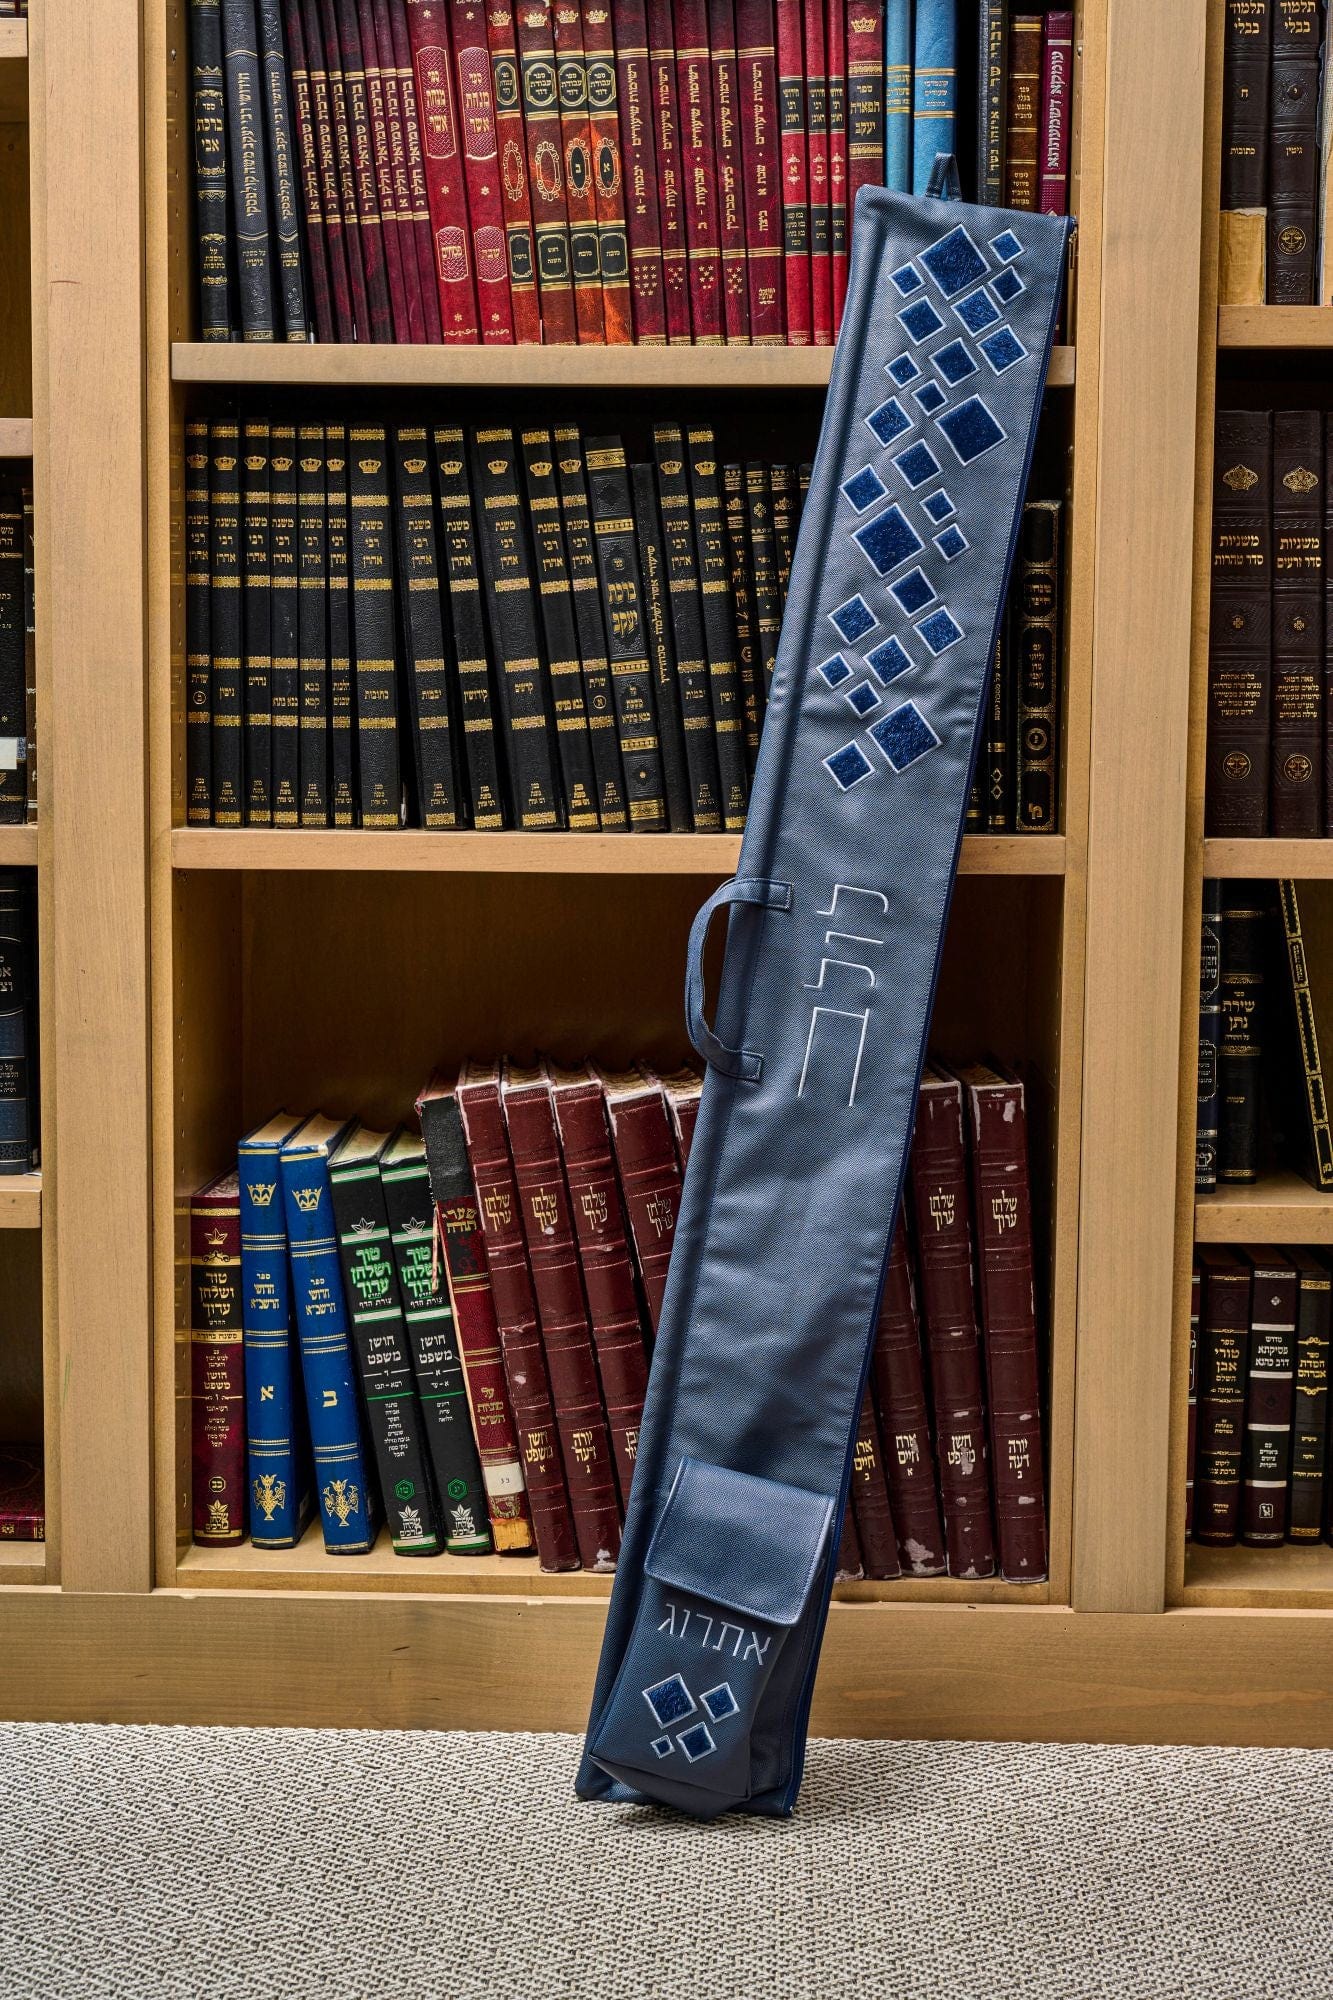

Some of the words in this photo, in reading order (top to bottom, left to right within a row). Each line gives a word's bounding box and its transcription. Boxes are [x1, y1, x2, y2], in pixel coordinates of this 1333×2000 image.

[1230, 2, 1265, 14] תלמוד
[1280, 0, 1316, 14] תלמוד
[1234, 19, 1260, 35] בבלי
[1284, 18, 1311, 34] בבלי
[989, 21, 1001, 58] דברי
[1050, 51, 1064, 95] עומקא
[627, 63, 639, 102] רשימות
[659, 66, 670, 105] רשימות
[689, 64, 700, 102] רשימות
[719, 64, 730, 103] רשימות
[752, 63, 763, 101] רשימות
[298, 82, 310, 120] ברכת
[316, 84, 328, 120] ברכת
[334, 84, 346, 120] ברכת
[352, 84, 365, 120] ברכת
[370, 80, 383, 116] ברכת
[386, 80, 398, 117] ברכת
[402, 80, 416, 116] ברכת
[466, 91, 489, 108] מנחת
[850, 100, 880, 114] תפארת
[196, 118, 224, 132] ברכת
[470, 117, 489, 133] אשר
[629, 106, 644, 146] שיעורים
[661, 110, 673, 150] שיעורים
[691, 108, 703, 148] שיעורים
[721, 108, 734, 147] שיעורים
[754, 104, 767, 145] שיעורים
[855, 121, 876, 135] יעקב
[200, 139, 220, 152] אבי
[302, 124, 316, 168] שמואל
[320, 124, 332, 169] שמואל
[338, 124, 350, 168] שמואל
[356, 125, 370, 170] שמואל
[375, 121, 388, 166] שמואל
[390, 122, 404, 166] שמואל
[407, 122, 420, 166] שמואל
[1230, 147, 1256, 155] כתובות
[576, 164, 581, 173] ב
[604, 163, 610, 172] א
[817, 165, 822, 174] ב
[306, 172, 318, 198] חלק
[324, 172, 338, 198] חלק
[342, 172, 355, 198] חלק
[360, 172, 375, 198] חלק
[378, 169, 393, 195] חלק
[394, 169, 409, 195] חלק
[411, 169, 426, 195] חלק
[634, 166, 645, 196] יבמות
[664, 170, 677, 207] שבועות
[694, 168, 708, 205] שבועות
[214, 517, 237, 528] משנת
[244, 516, 267, 527] משנת
[272, 518, 294, 528] משנת
[300, 519, 322, 528] משנת
[328, 518, 347, 528] משנת
[361, 520, 383, 530] משנת
[408, 520, 431, 530] משנת
[447, 520, 470, 532] משנת
[496, 520, 515, 532] משנת
[538, 522, 560, 534] משנת
[566, 520, 590, 530] משנת
[666, 520, 689, 532] משנת
[219, 535, 232, 544] רבי
[249, 535, 263, 544] רבי
[276, 536, 290, 546] רבי
[305, 536, 318, 546] רבי
[331, 536, 344, 546] רבי
[365, 538, 380, 548] רבי
[414, 538, 428, 548] רבי
[452, 538, 467, 549] רבי
[501, 538, 514, 548] רבי
[543, 540, 559, 550] רבי
[572, 538, 588, 547] רבי
[673, 539, 687, 549] רבי
[1220, 535, 1260, 546] משניות
[1280, 538, 1320, 550] משניות
[216, 553, 236, 566] אהרן
[247, 552, 266, 565] אהרן
[273, 553, 293, 566] אהרן
[302, 554, 321, 567] אהרן
[330, 554, 346, 567] אהרן
[363, 556, 382, 568] אהרן
[412, 555, 432, 568] אהרן
[451, 556, 472, 570] אהרן
[500, 555, 519, 569] אהרן
[543, 557, 564, 571] אהרן
[572, 555, 592, 568] אהרן
[672, 556, 692, 570] אהרן
[1214, 554, 1243, 565] טהרות
[1246, 554, 1263, 565] סדר
[1277, 557, 1302, 568] זרעים
[1304, 557, 1321, 568] סדר
[608, 582, 637, 604] ברכת
[612, 611, 637, 635] יעקב
[365, 690, 388, 700] כתובות
[798, 884, 889, 1106] לולב
[1223, 1000, 1255, 1013] שירת
[1229, 1016, 1249, 1031] נתן
[485, 1187, 510, 1213] שלחן
[531, 1187, 557, 1213] שלחן
[581, 1185, 606, 1212] שלחן
[929, 1188, 954, 1213] שלחן
[992, 1190, 1017, 1216] שלחן
[646, 1193, 671, 1220] שלחן
[489, 1209, 511, 1232] ערוך
[535, 1209, 558, 1232] ערוך
[584, 1207, 607, 1230] ערוך
[650, 1214, 674, 1238] ערוך
[932, 1210, 954, 1231] ערוך
[993, 1214, 1016, 1235] ערוך
[356, 1247, 380, 1262] טור
[205, 1273, 228, 1284] טור
[351, 1262, 392, 1280] ושלחן
[198, 1286, 234, 1304] ושלחן
[357, 1278, 389, 1297] ערוך
[202, 1303, 230, 1317] ערוך
[368, 1335, 394, 1351] חושן
[420, 1335, 445, 1351] חושן
[1258, 1345, 1288, 1356] פסיקתא
[367, 1350, 402, 1365] משפט
[419, 1349, 452, 1365] משפט
[1214, 1348, 1240, 1359] טורי
[1216, 1361, 1237, 1373] אבן
[1298, 1369, 1326, 1378] אברהם
[207, 1372, 227, 1381] חושן
[204, 1382, 231, 1390] משפט
[260, 1385, 274, 1401] א
[322, 1390, 338, 1408] ב
[573, 1431, 593, 1444] יורה
[952, 1434, 971, 1453] חשן
[1008, 1439, 1028, 1454] יורה
[526, 1446, 553, 1463] משפט
[898, 1450, 920, 1464] חיים
[1009, 1454, 1030, 1469] דעה
[539, 1465, 546, 1473] א
[854, 1454, 875, 1471] חיים
[864, 1472, 870, 1480] ב
[907, 1468, 913, 1476] א
[1017, 1471, 1022, 1479] ב
[658, 1603, 771, 1666] אתרוג
